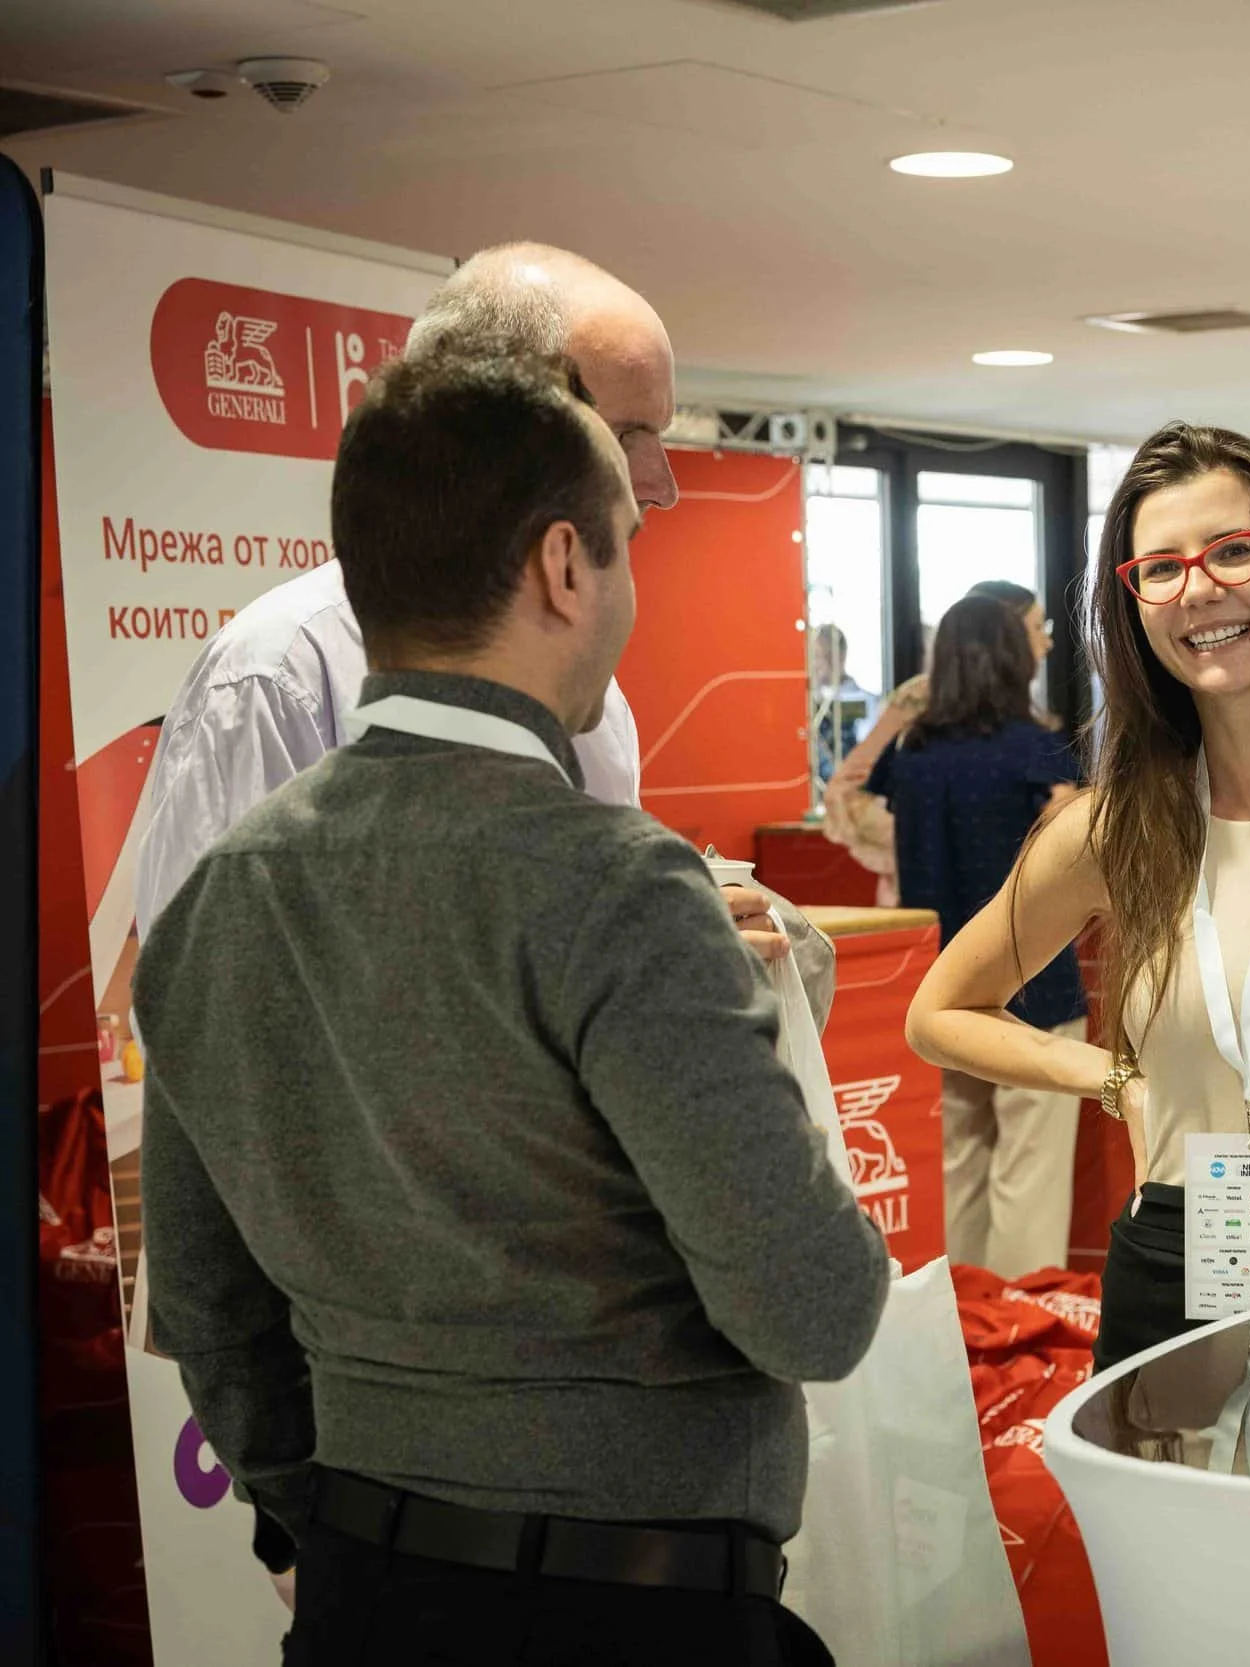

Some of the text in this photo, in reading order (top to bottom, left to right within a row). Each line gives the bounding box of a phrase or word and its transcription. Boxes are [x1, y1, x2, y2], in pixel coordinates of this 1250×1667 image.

[207, 392, 286, 425] GENERALI
[102, 516, 335, 573] Мрежа от хор
[108, 606, 208, 640] които
